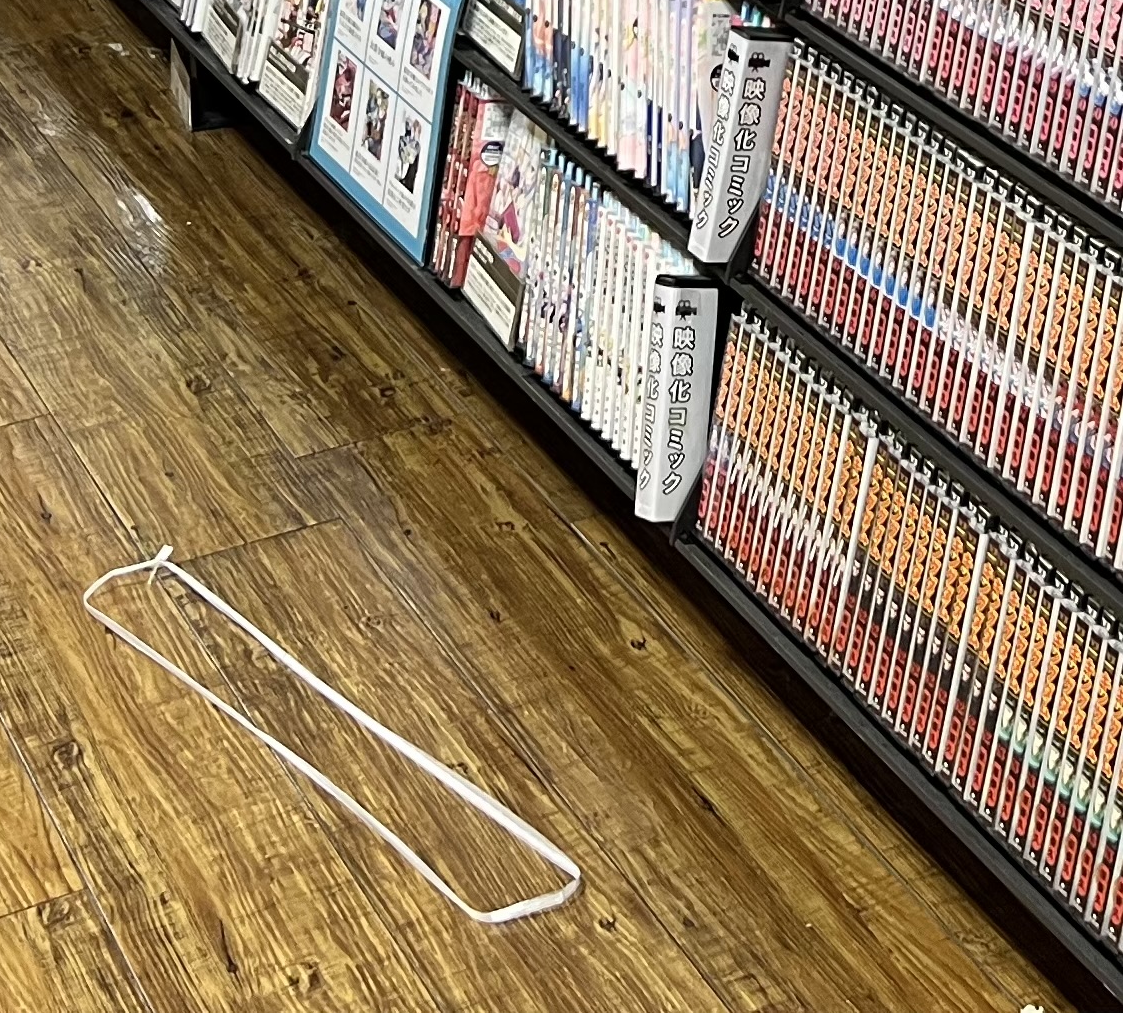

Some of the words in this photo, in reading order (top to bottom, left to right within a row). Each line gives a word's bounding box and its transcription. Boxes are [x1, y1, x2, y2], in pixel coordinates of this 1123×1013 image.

[694, 68, 736, 231] 映像化コミック
[717, 77, 767, 239] 映像化コミック
[638, 321, 665, 490] 映像化コミック
[662, 325, 697, 496] 映像化コミック
